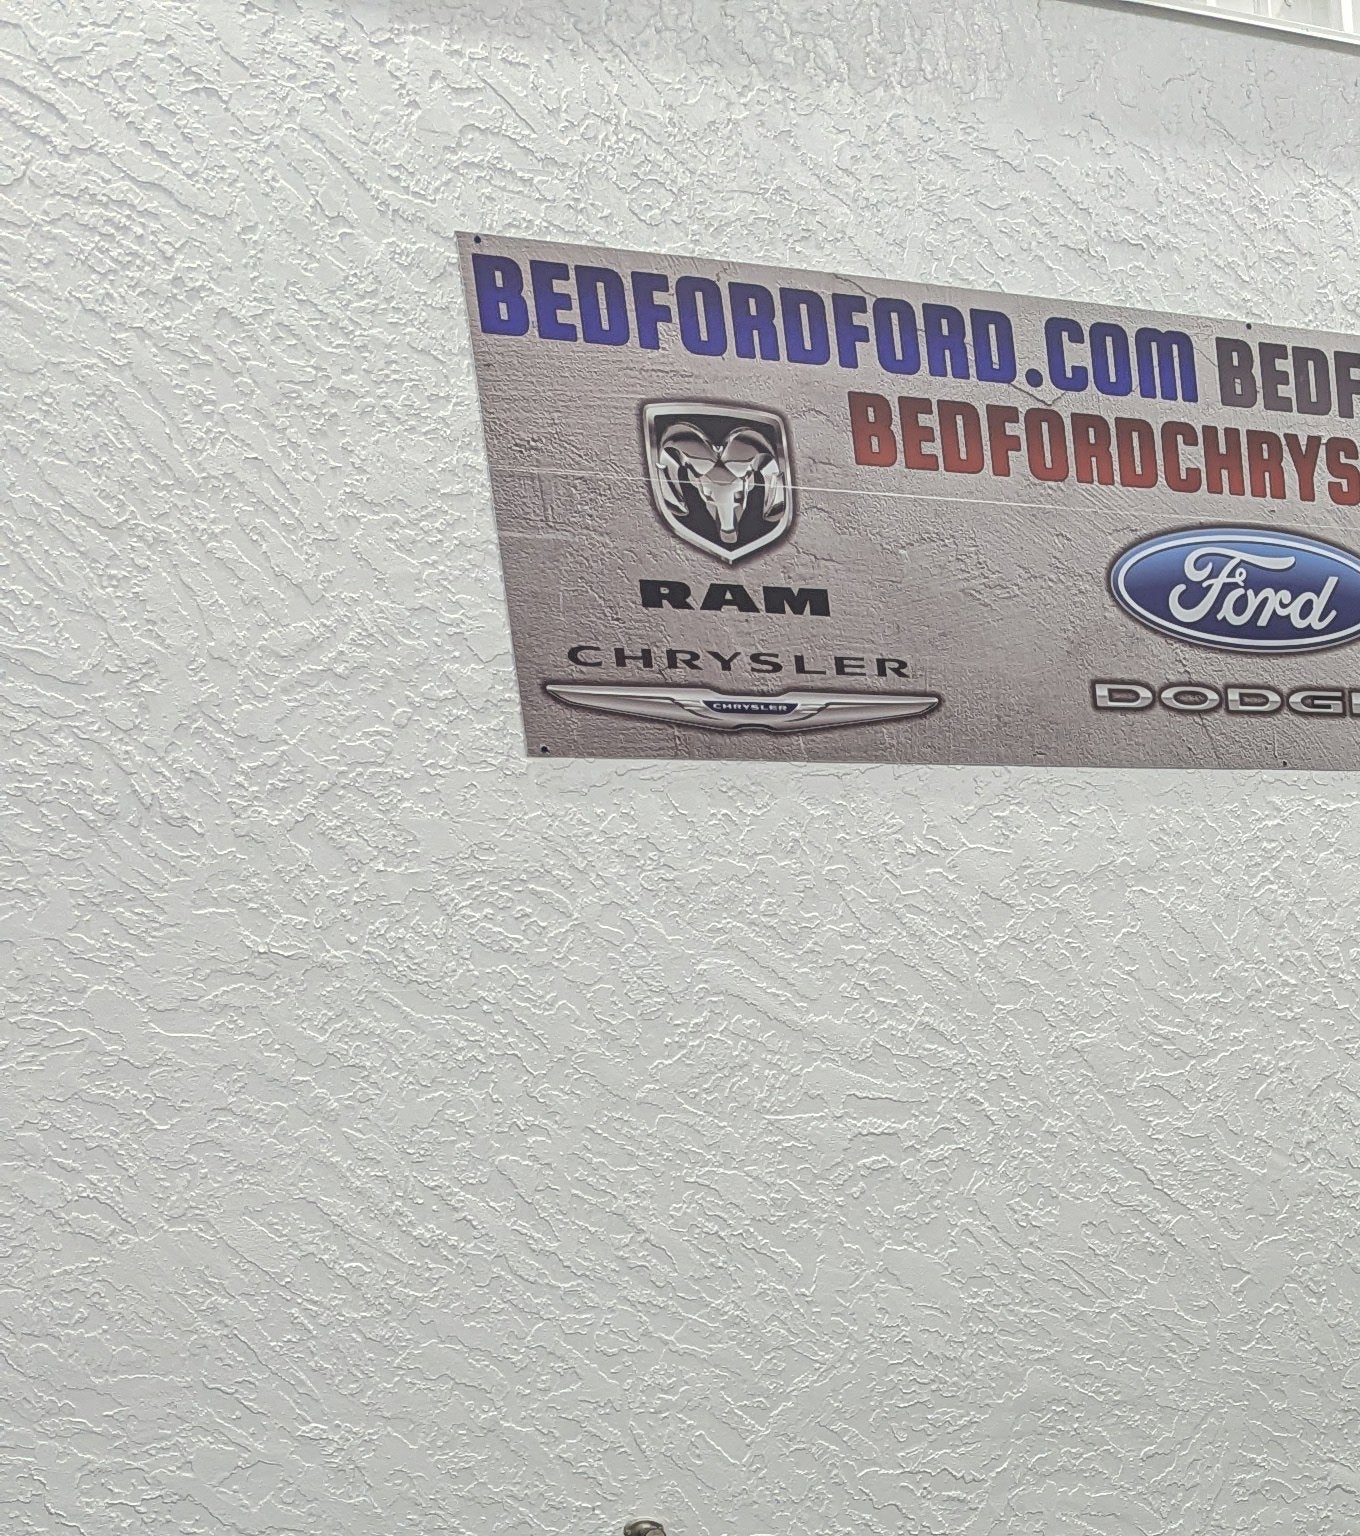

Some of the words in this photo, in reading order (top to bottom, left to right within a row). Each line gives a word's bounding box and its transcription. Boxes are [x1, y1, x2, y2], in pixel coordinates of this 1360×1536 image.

[471, 252, 1199, 402] BEDFORDFORD.COM
[639, 578, 831, 617] RAM
[1168, 546, 1339, 630] Ford
[567, 645, 910, 679] CHRYSLER
[711, 701, 790, 713] CHRYSLER
